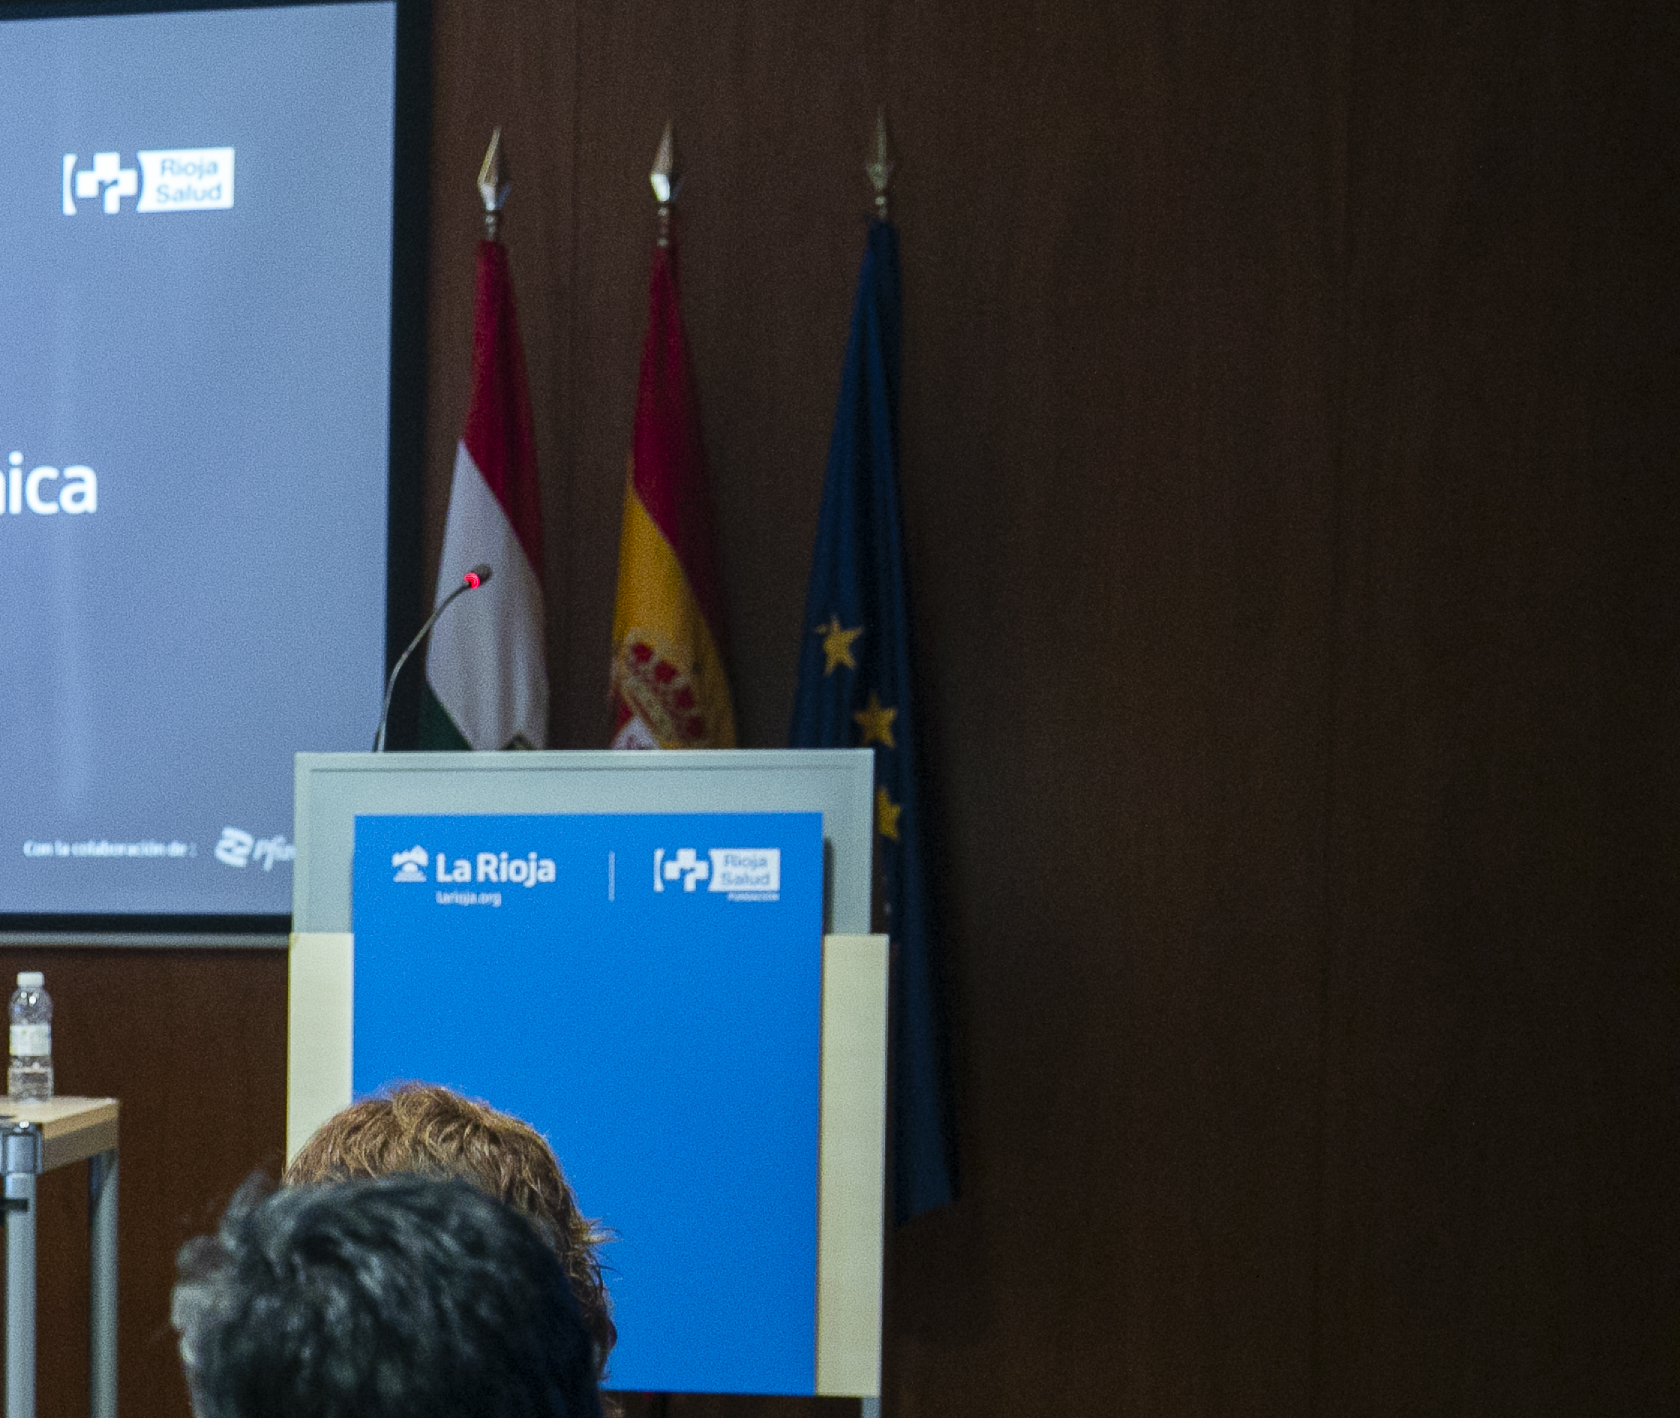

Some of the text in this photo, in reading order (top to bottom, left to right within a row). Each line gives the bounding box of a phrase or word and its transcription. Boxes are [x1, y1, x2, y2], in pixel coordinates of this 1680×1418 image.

[160, 158, 219, 182] Rioja
[156, 183, 223, 204] Salud
[436, 851, 557, 889] La Rioja
